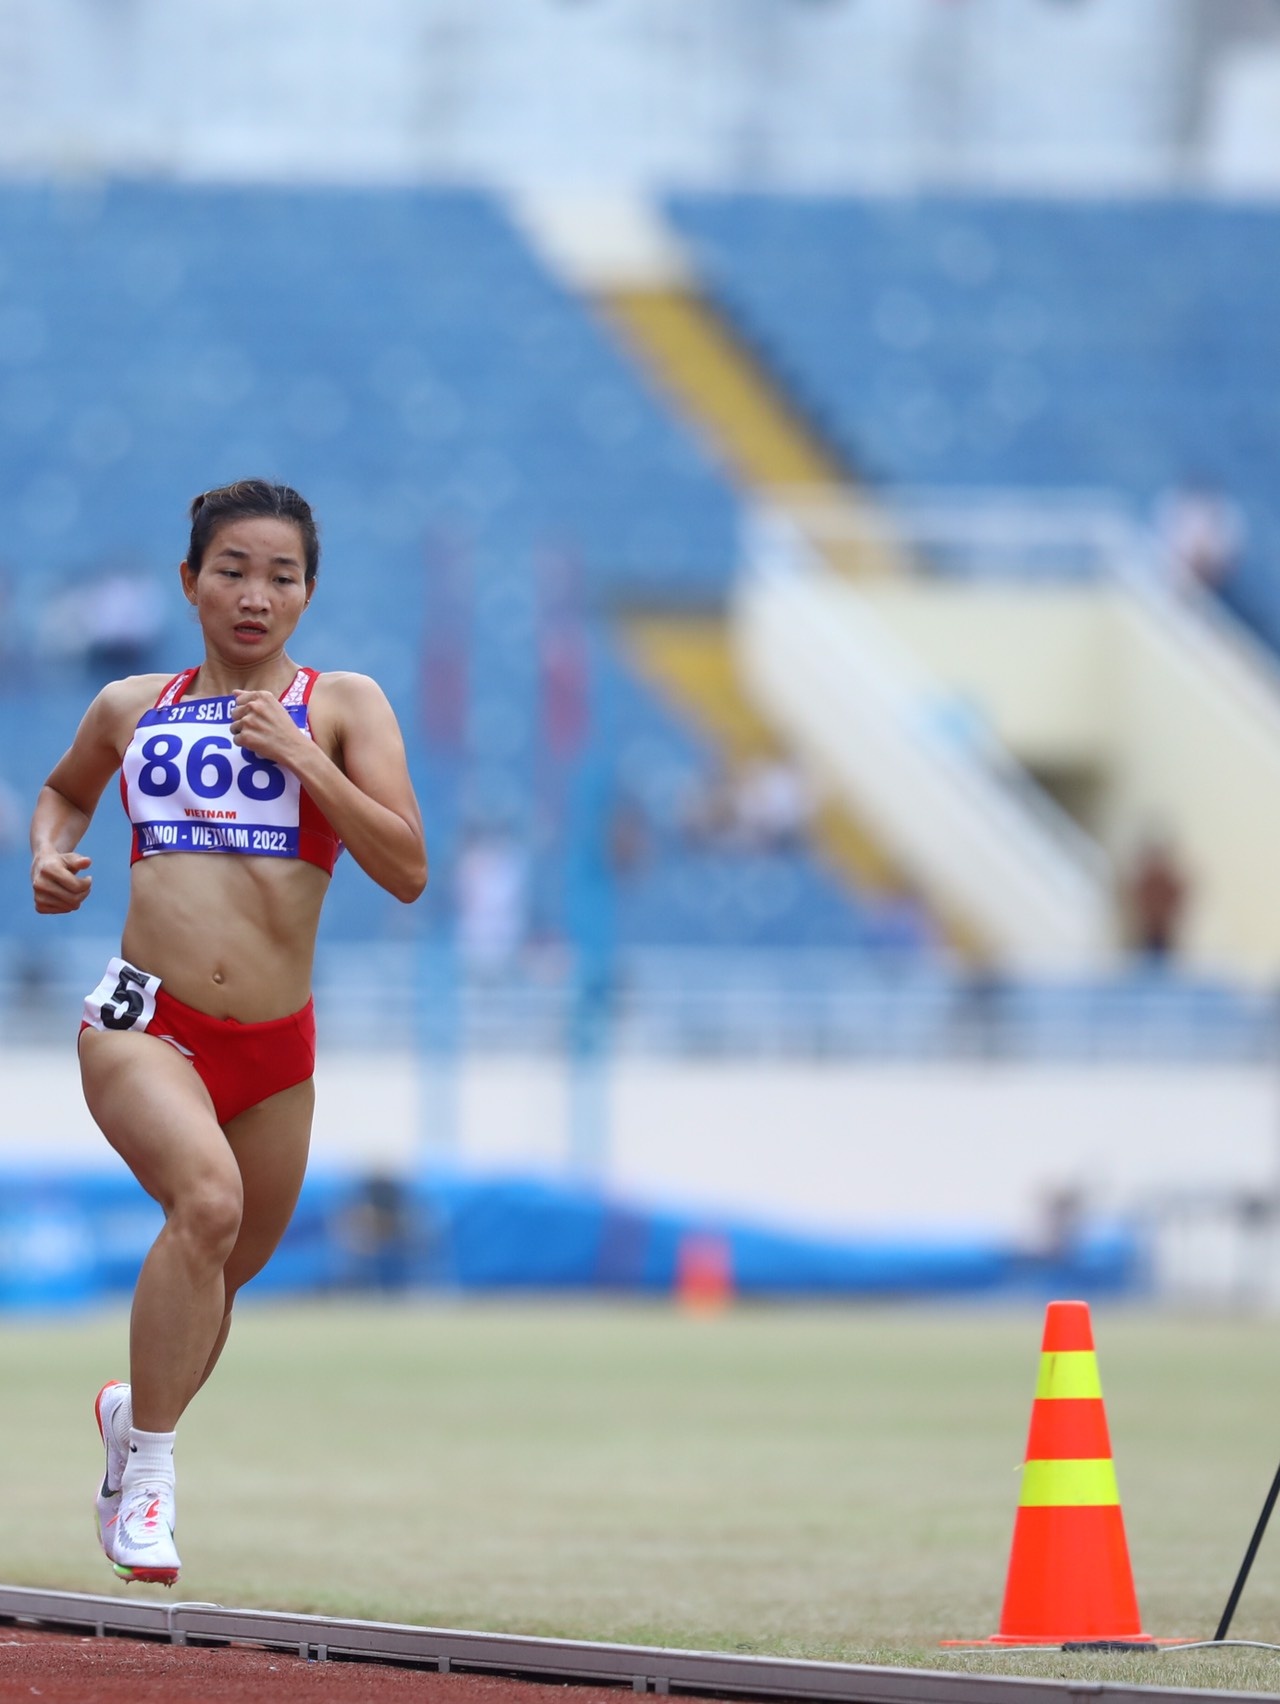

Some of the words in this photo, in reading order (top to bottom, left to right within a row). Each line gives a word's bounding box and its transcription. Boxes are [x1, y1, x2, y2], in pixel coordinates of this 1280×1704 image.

[196, 702, 223, 721] SEA
[138, 733, 286, 801] 868
[184, 808, 237, 819] VIETNAM
[252, 829, 287, 852] 2022
[101, 965, 151, 1031] 5
